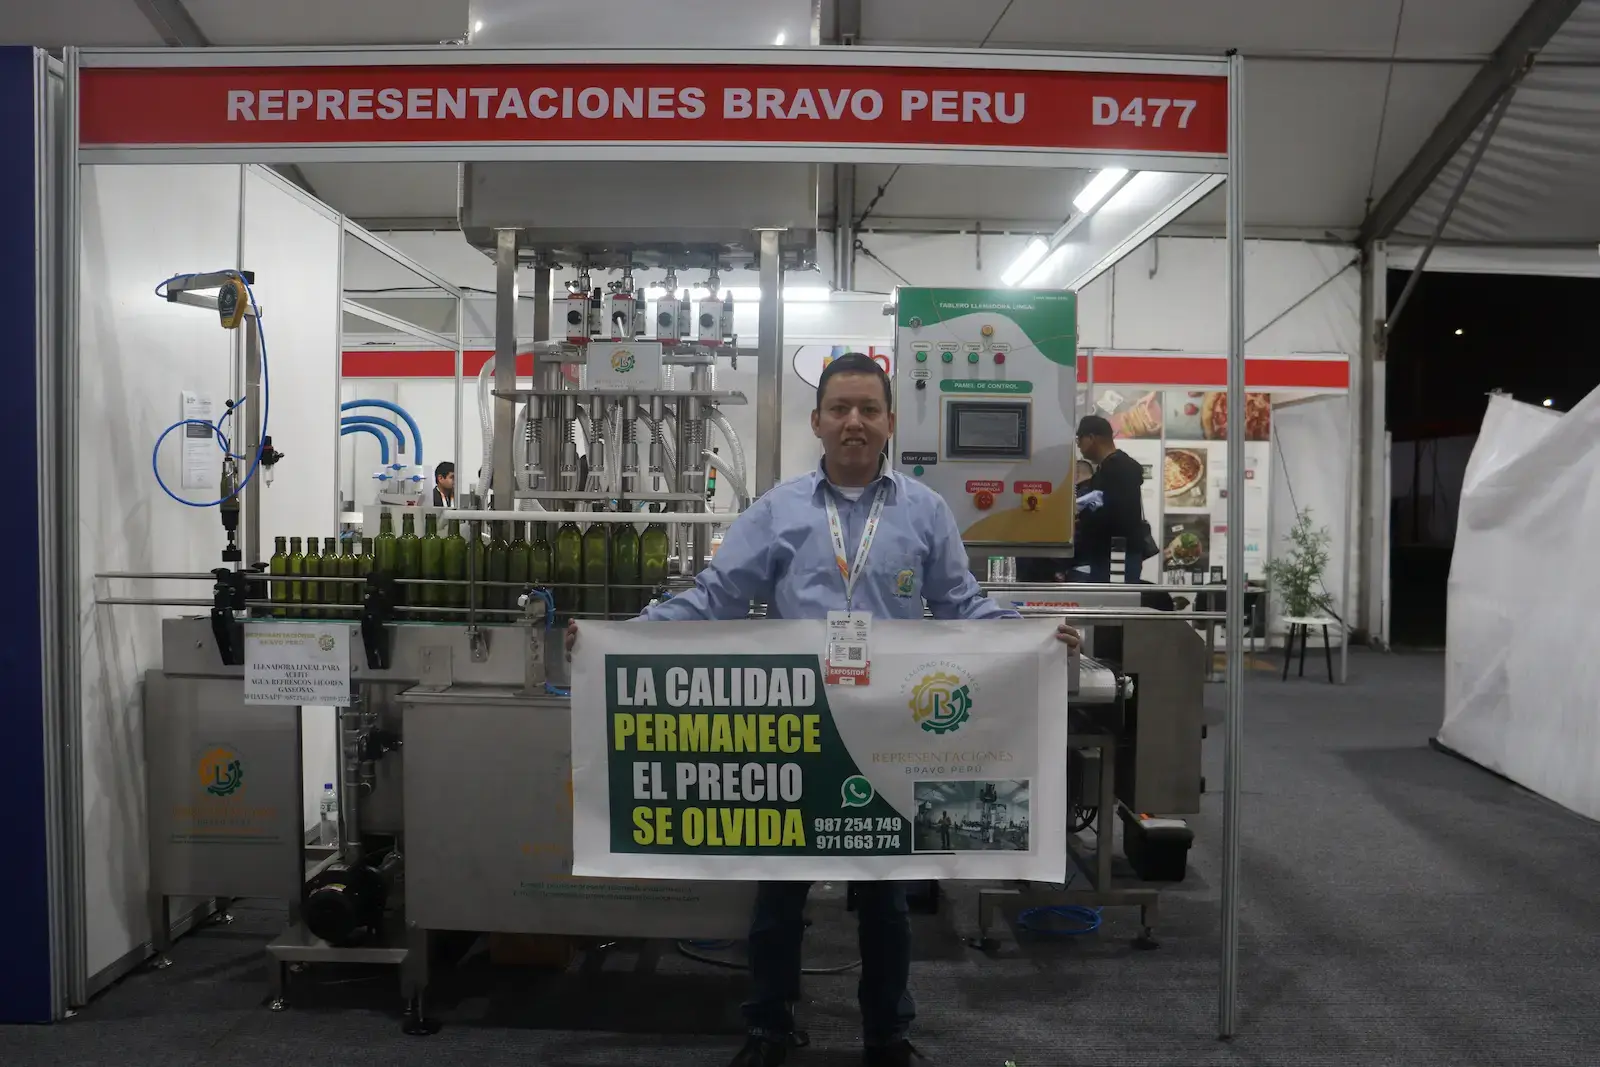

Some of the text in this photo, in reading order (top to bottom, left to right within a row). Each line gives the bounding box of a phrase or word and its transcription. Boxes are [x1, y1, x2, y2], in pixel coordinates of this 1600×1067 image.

[226, 87, 1026, 125] REPRESENTACIONES BRAVO PERU
[1092, 96, 1197, 129] D477
[253, 663, 340, 672] LLENADORA LINEAL PARA
[830, 668, 865, 676] EXPOSITOR
[905, 661, 937, 682] CALIDAD
[616, 666, 816, 708] LA CALIDAD
[614, 713, 821, 754] PERMANECE
[871, 751, 1014, 764] REPRESENTACIONES
[905, 766, 946, 775] BRAVO
[632, 761, 803, 802] EL PRECIO
[632, 806, 807, 847] SE OLVIDA
[814, 817, 902, 833] 987 254 749
[816, 834, 901, 850] 971 663 774
